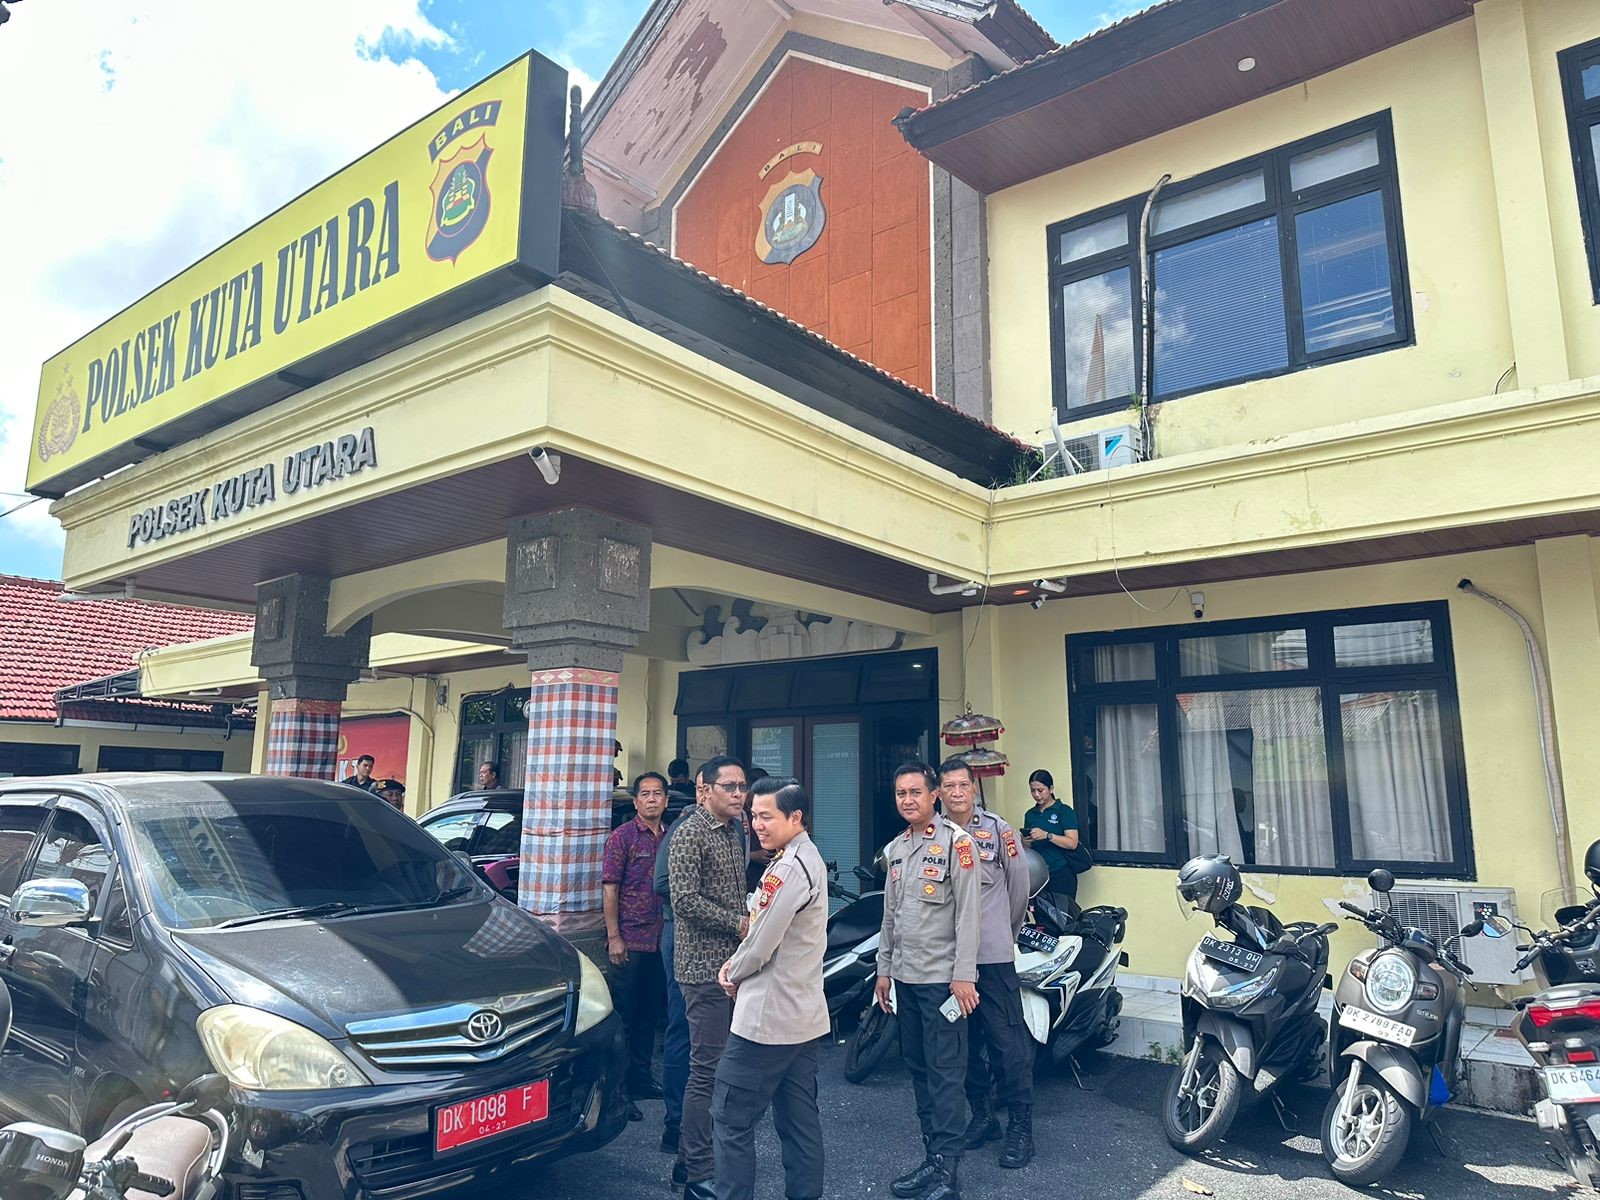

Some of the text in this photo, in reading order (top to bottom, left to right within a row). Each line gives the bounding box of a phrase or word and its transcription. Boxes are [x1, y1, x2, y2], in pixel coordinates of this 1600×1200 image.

[435, 104, 492, 151] BALI
[763, 144, 817, 172] BALI
[81, 179, 400, 434] POLSEK KUTA UTARA
[127, 426, 378, 549] POLSEK KUTA UTARA
[922, 856, 946, 865] POLRI
[1203, 937, 1216, 947] DK
[1217, 943, 1242, 956] 2313
[1346, 1007, 1361, 1017] DK
[1550, 1072, 1568, 1084] DK
[443, 1086, 532, 1134] DK 1098 F
[36, 1153, 69, 1169] HONDA
